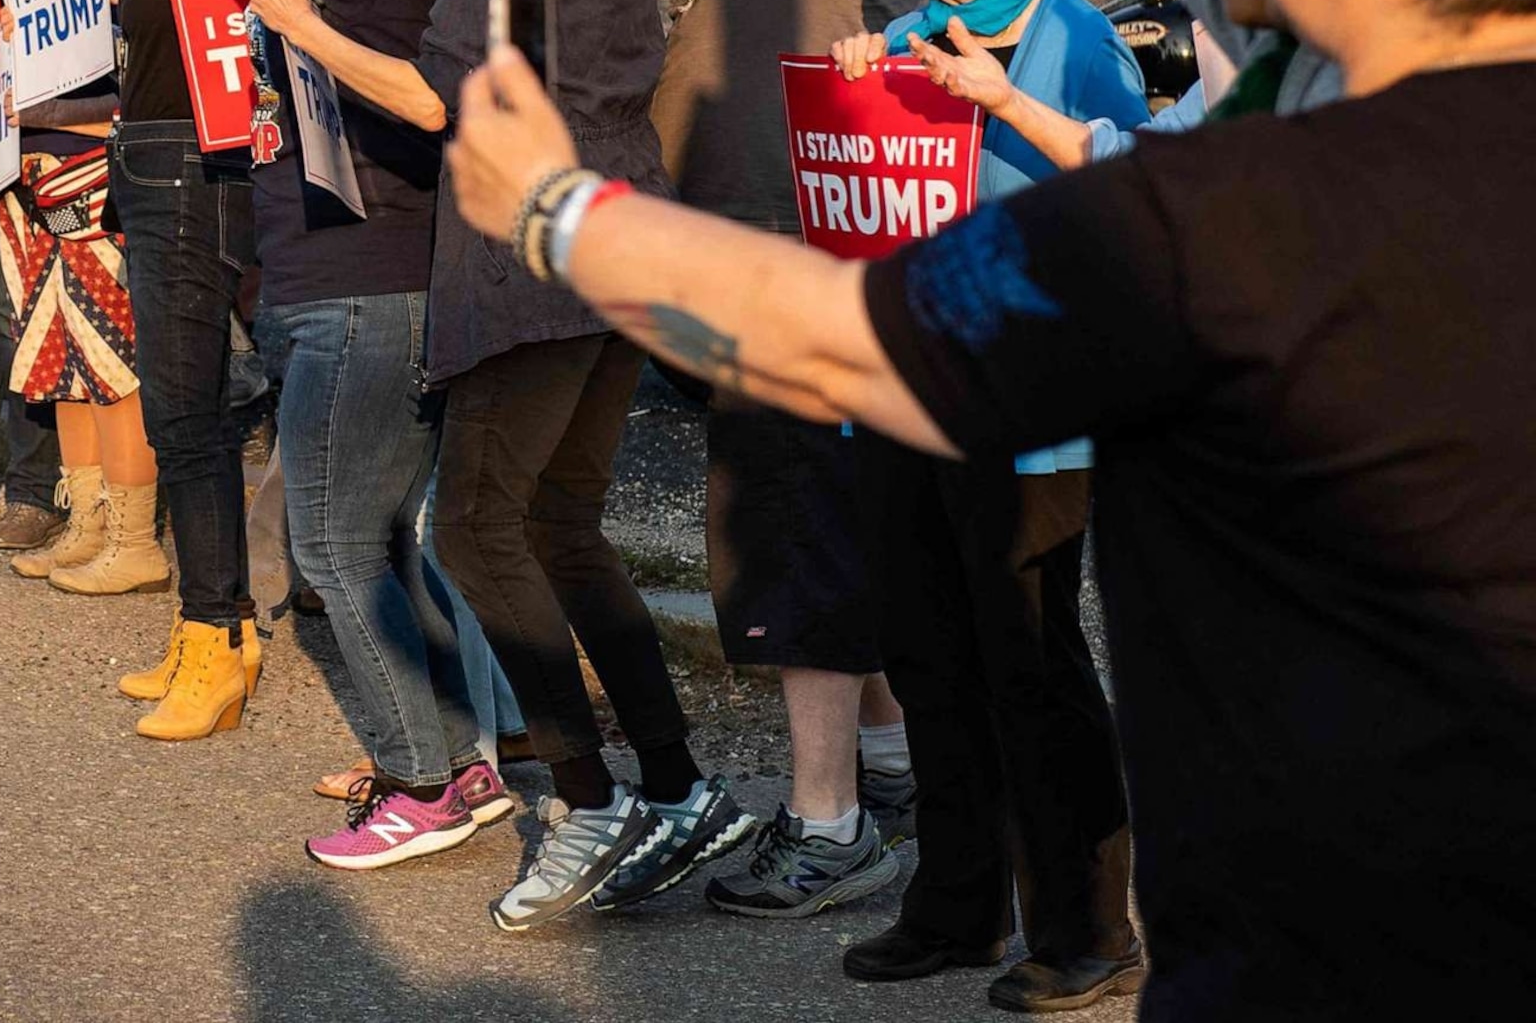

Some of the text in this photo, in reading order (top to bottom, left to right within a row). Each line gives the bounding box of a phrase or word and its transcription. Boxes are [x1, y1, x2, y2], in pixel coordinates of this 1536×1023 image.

[796, 130, 957, 168] I STAND WITH
[799, 169, 958, 239] TRUMP
